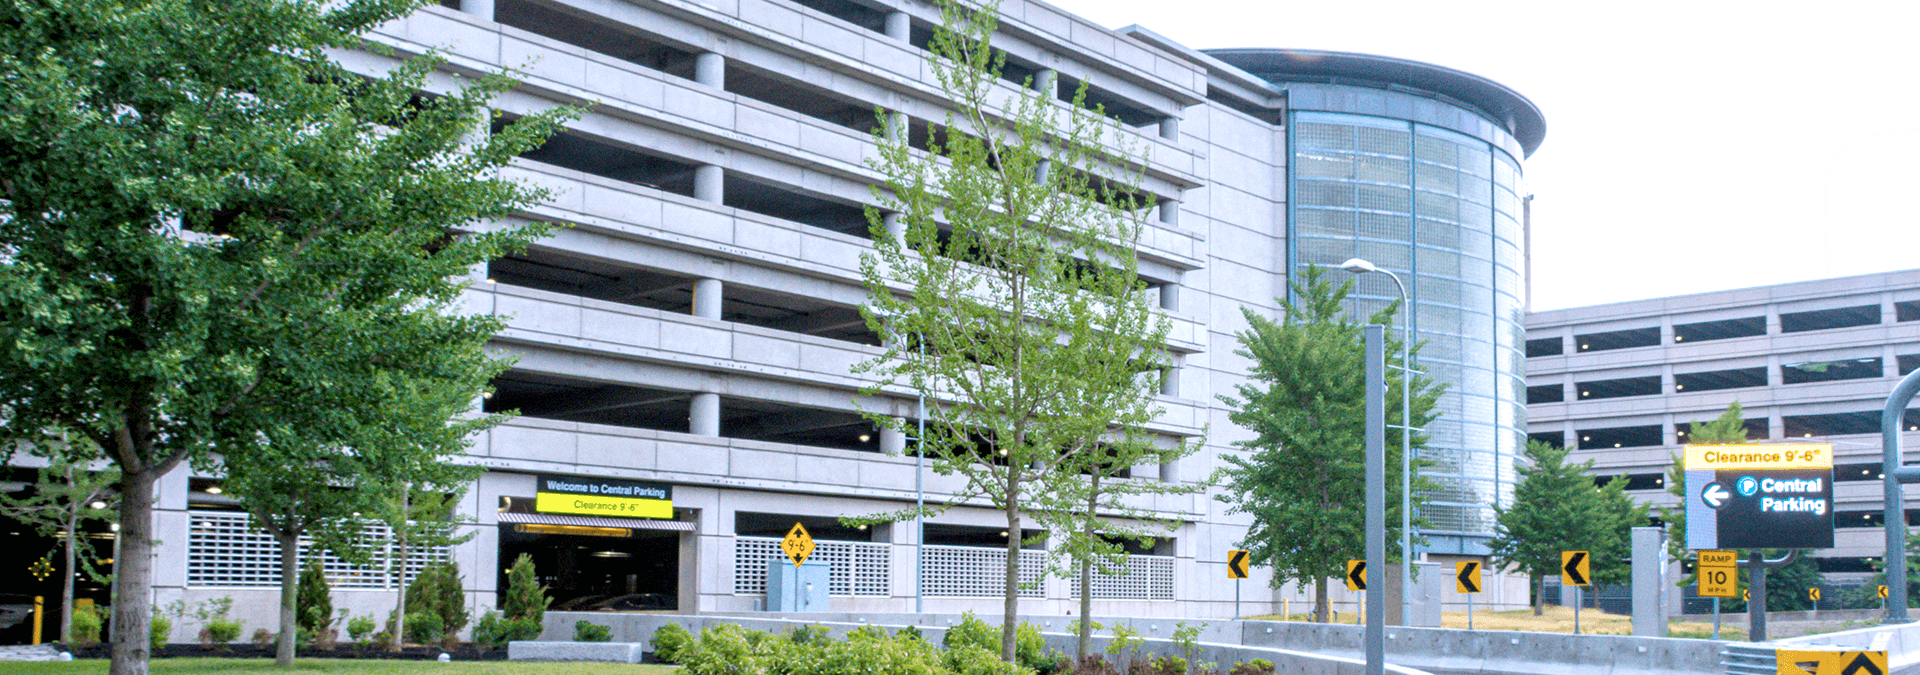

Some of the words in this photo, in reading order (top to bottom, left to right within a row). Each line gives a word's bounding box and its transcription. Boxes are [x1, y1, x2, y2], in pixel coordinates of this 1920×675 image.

[1704, 451, 1781, 464] Clearance
[546, 480, 589, 493] Welcome
[590, 484, 599, 493] to
[600, 484, 632, 495] Central
[634, 486, 666, 499] Parking
[1760, 477, 1823, 493] Central
[574, 500, 618, 511] Clearance
[1760, 496, 1826, 516] Parking
[1702, 555, 1732, 563] RAMP
[1708, 571, 1727, 585] 10
